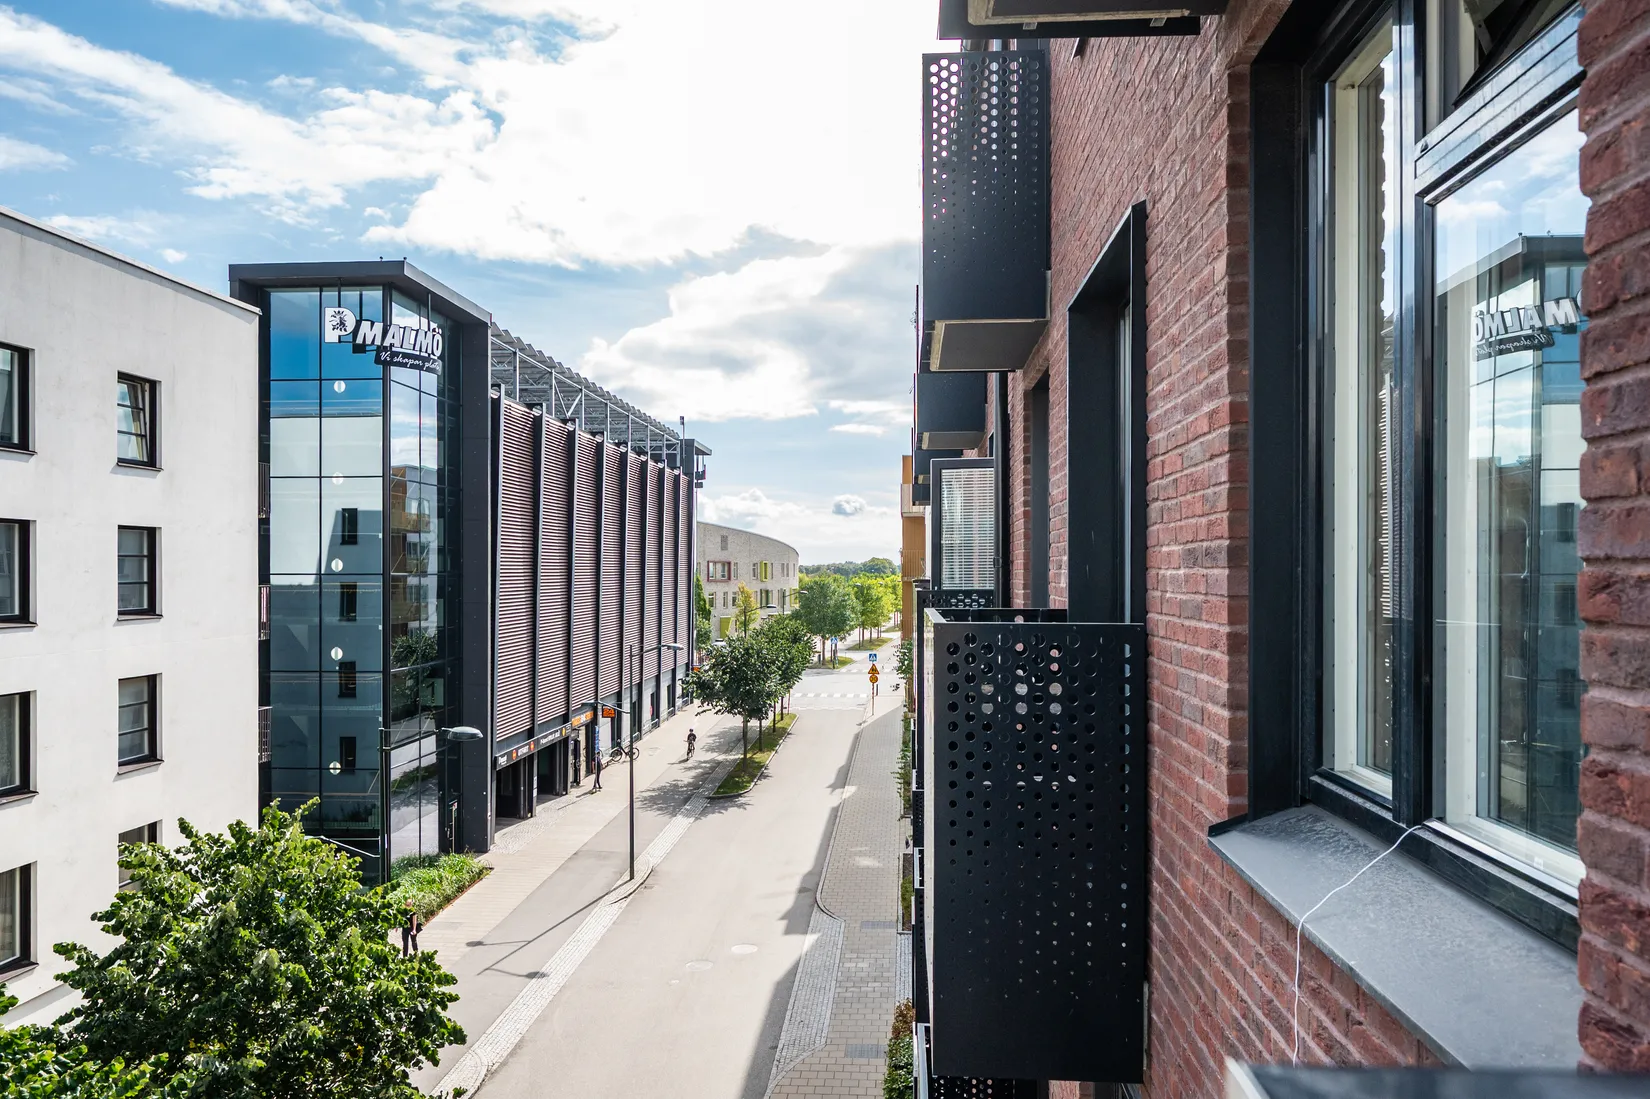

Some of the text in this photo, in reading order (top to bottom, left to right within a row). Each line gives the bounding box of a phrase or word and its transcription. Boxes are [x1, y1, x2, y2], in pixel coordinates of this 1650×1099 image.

[356, 320, 443, 358] MALMÖ
[380, 351, 391, 361] Vi
[393, 353, 424, 368] skapar
[426, 681, 435, 704] 1
